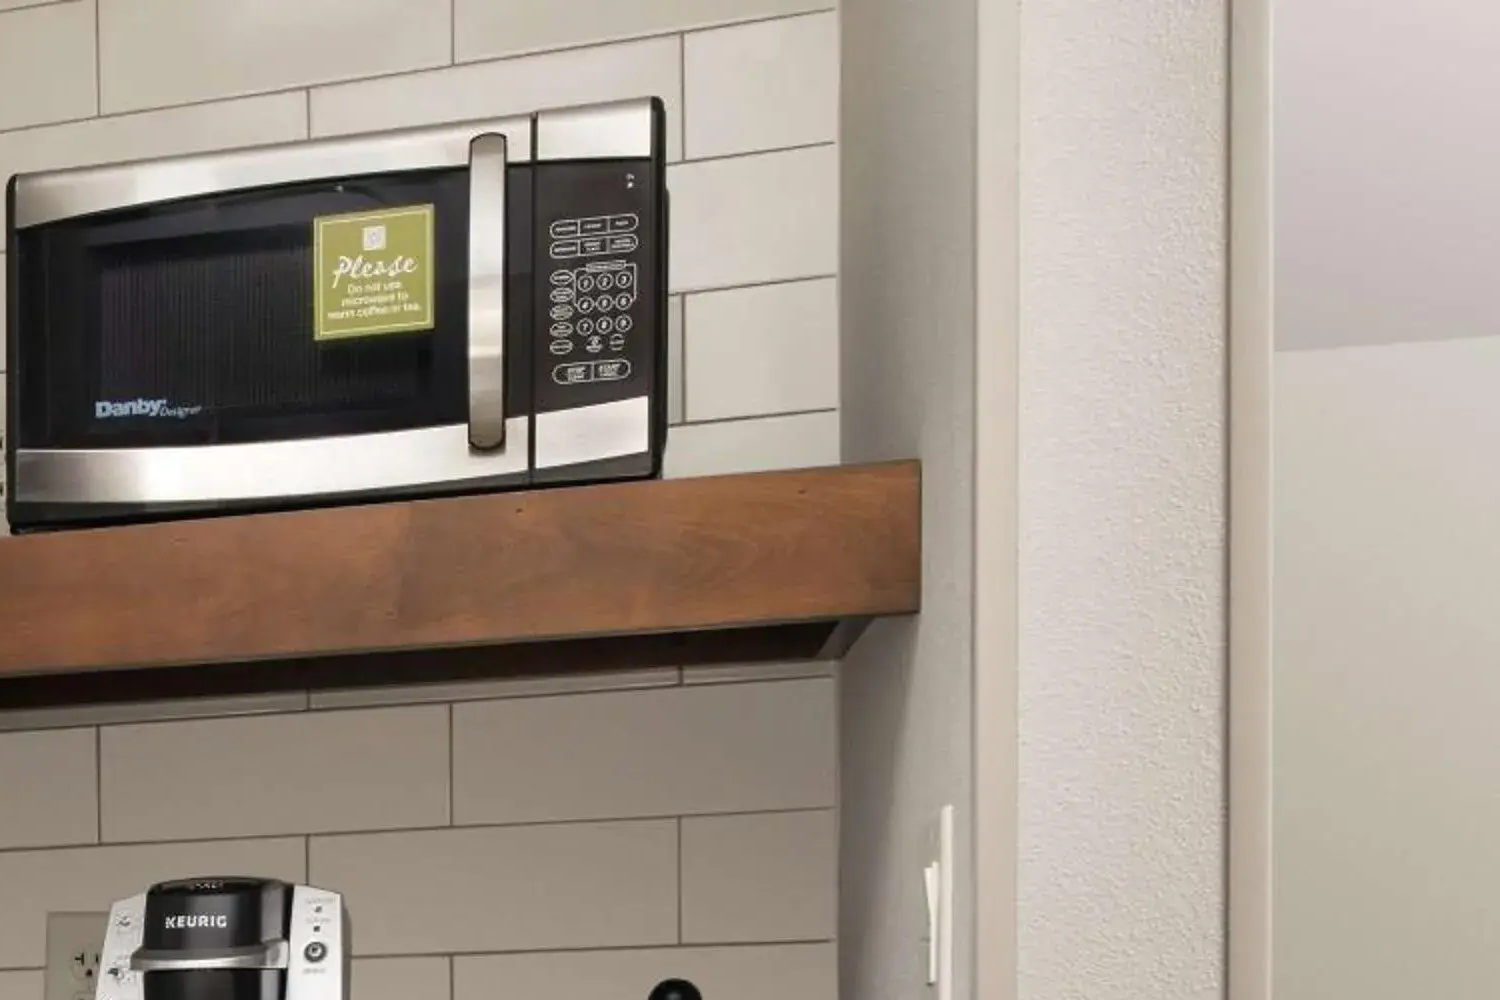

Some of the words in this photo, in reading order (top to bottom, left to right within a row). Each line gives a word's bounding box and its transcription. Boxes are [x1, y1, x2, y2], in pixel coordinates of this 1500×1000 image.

[332, 255, 417, 288] Please
[95, 398, 166, 419] Danby
[165, 915, 227, 929] KEURIG
